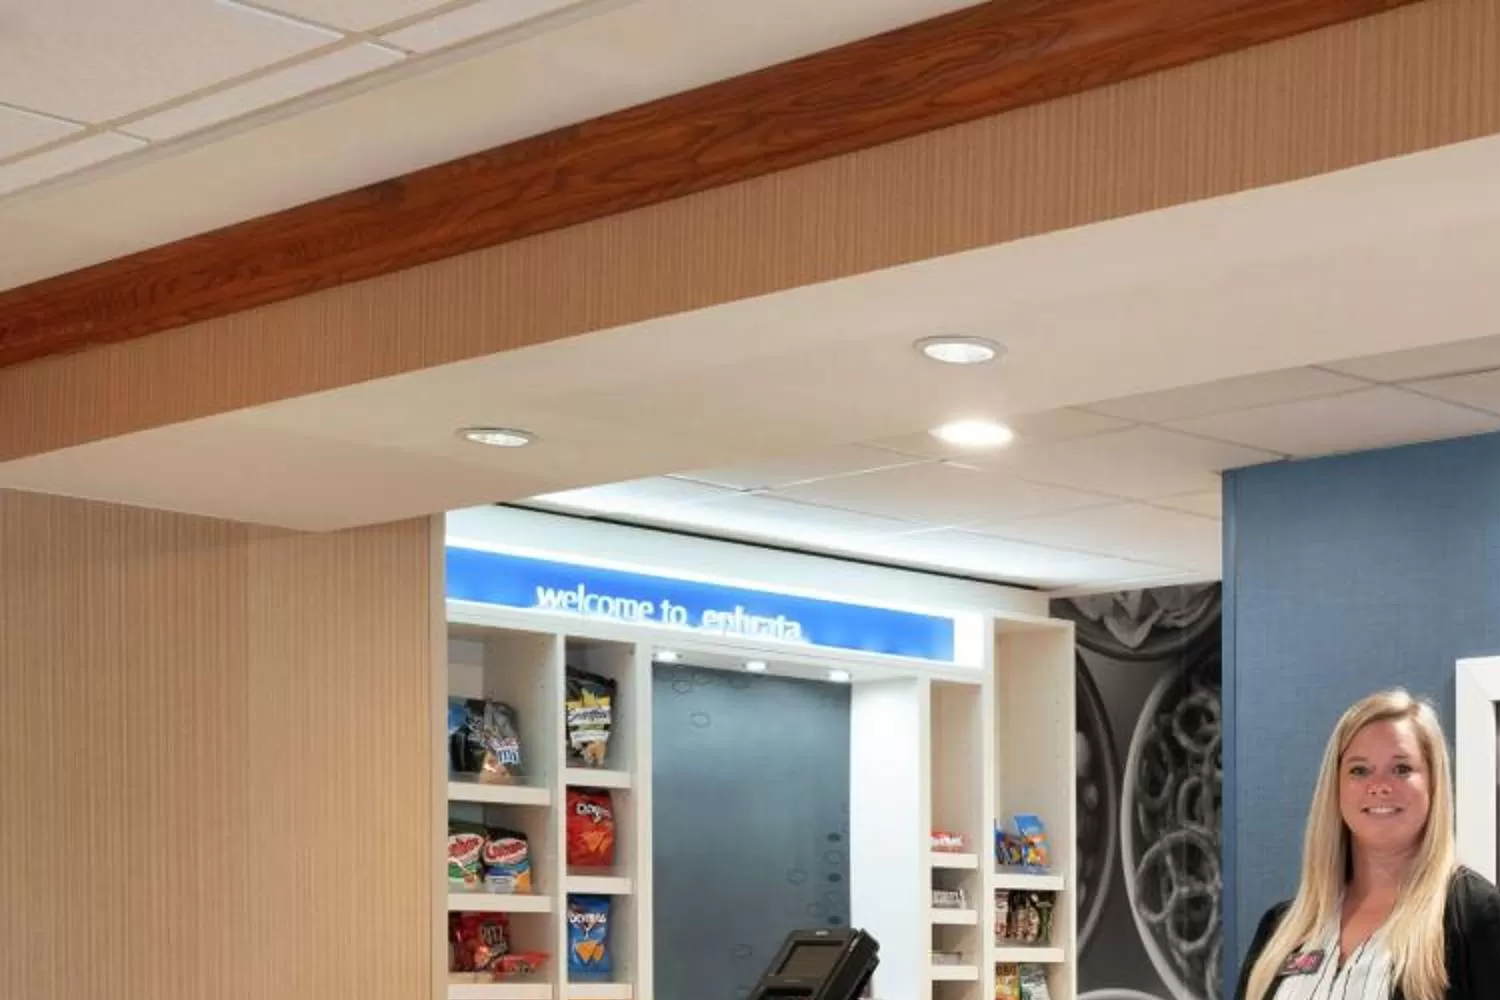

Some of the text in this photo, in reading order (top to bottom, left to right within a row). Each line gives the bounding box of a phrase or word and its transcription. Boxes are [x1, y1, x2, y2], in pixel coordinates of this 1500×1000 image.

[536, 582, 802, 641] welcome to ephrata
